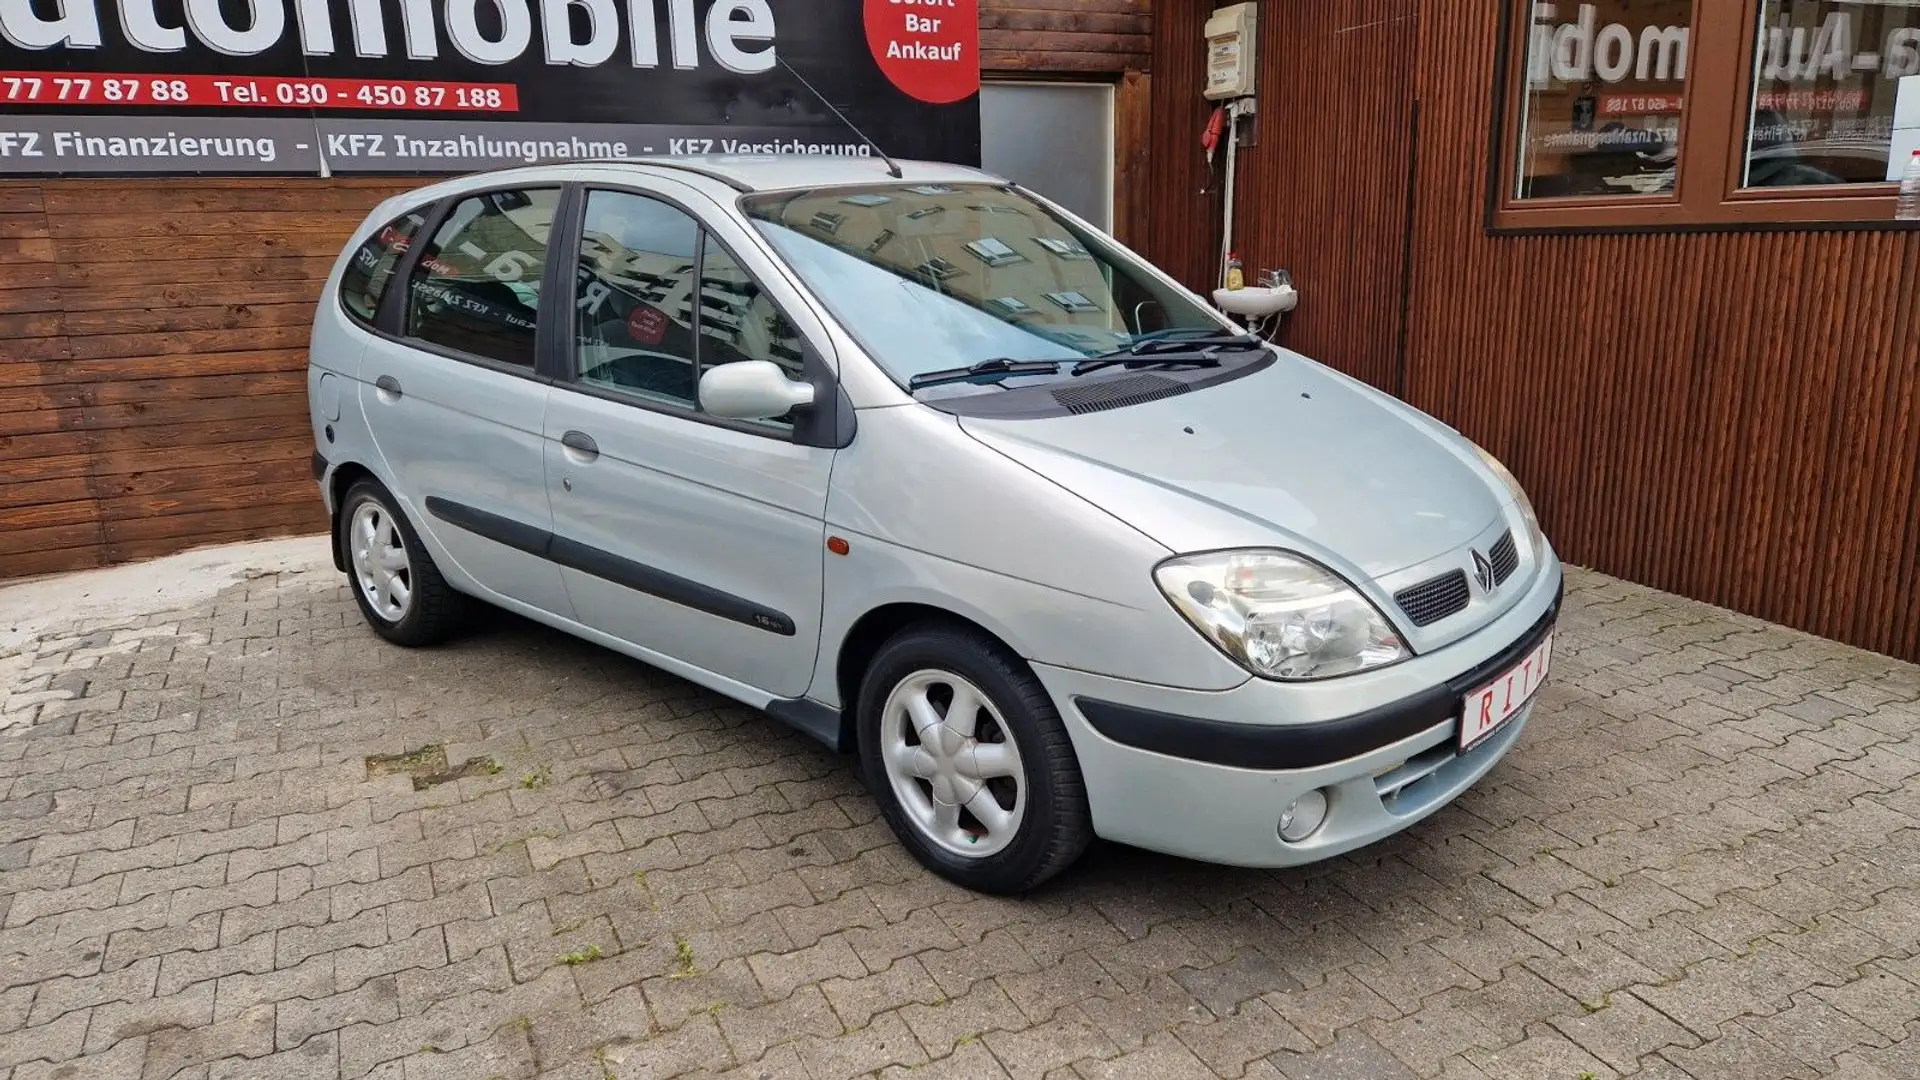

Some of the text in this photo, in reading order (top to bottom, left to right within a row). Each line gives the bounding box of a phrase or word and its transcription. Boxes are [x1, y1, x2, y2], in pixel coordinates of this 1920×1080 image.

[904, 13, 941, 33] Bar
[886, 40, 962, 61] Ankauf
[3, 77, 43, 100] 77
[53, 78, 92, 100] 77
[103, 79, 140, 101] 87
[151, 80, 189, 101] 88
[213, 81, 267, 103] Tel.
[276, 83, 328, 104] 030
[357, 85, 406, 106] 450
[415, 87, 445, 106] 87
[456, 88, 502, 107] 188
[53, 132, 276, 162] Finanzierung
[327, 134, 386, 157] KFZ
[394, 135, 628, 162] Inzahlungnahme
[669, 138, 713, 155] KFZ
[721, 139, 871, 157] Versicherung
